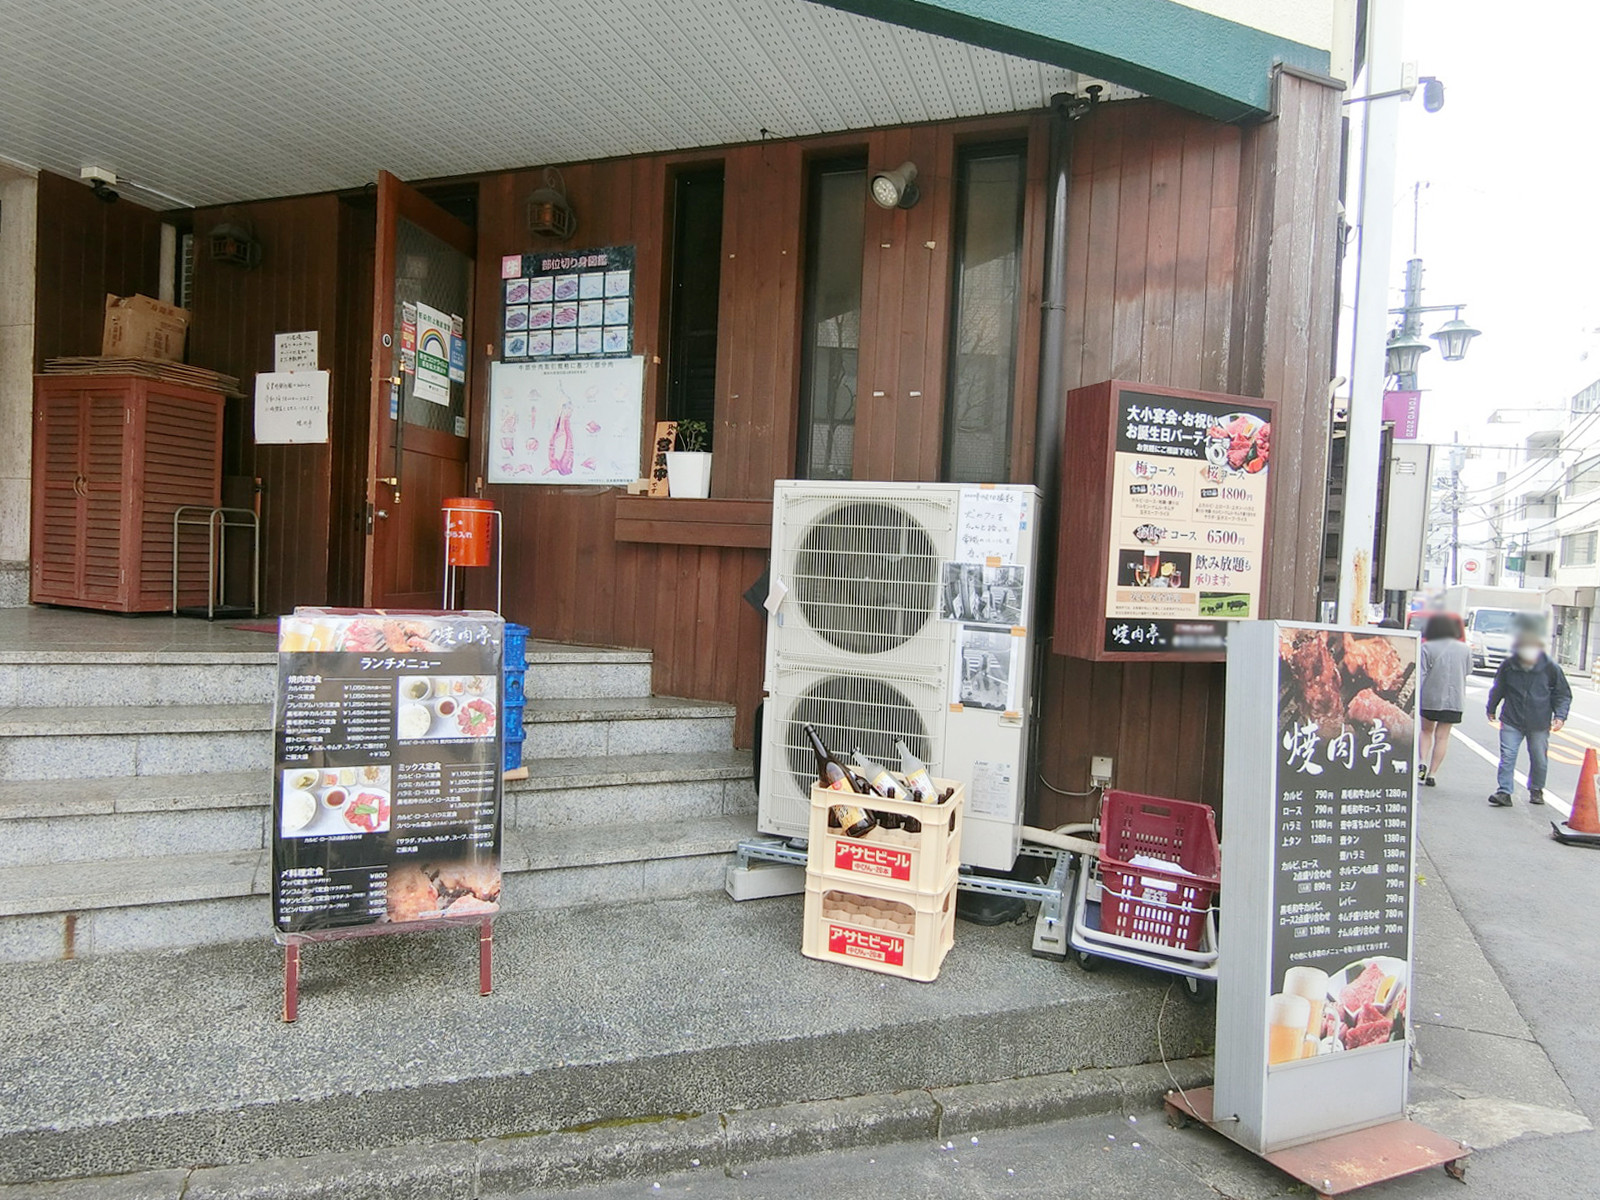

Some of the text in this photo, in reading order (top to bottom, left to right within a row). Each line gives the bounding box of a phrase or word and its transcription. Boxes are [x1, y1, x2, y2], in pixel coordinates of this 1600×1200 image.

[541, 255, 608, 271] 部位切り身図鑑
[1126, 404, 1219, 428] 大小宴会・お祝い
[1405, 397, 1416, 437] TOKYO 2020
[1149, 483, 1184, 498] 3500円
[1221, 487, 1253, 501] 4800円
[1207, 529, 1245, 545] 6500円
[1195, 554, 1251, 572] 飲み放題も
[1195, 573, 1232, 587] 承ります。
[434, 625, 492, 645] 焼肉亭
[1112, 623, 1160, 645] 焼肉亭
[360, 657, 441, 670] ランチメニュー
[288, 675, 322, 684] 焼肉定食
[1283, 718, 1392, 775] 焼肉亭
[398, 762, 441, 771] ミックス定食
[1283, 788, 1407, 801] カルビ 790円 黒毛和牛カルビ 1280円
[1282, 803, 1407, 816] ロース 790円 黒毛和牛ロース 1280円
[1282, 821, 1301, 831] ハラミ
[1311, 820, 1333, 830] 1180円
[1281, 836, 1302, 847] 上タン
[1310, 835, 1332, 845] 1280円
[837, 843, 910, 868] アサヒビール
[1313, 882, 1332, 892] 890円
[1339, 881, 1357, 892] 上ミノ
[1386, 879, 1405, 889] 790円
[1339, 894, 1405, 907] レバー 790円
[1338, 909, 1381, 923] キムチ盛り合わせ
[1384, 908, 1404, 919] 780円
[1337, 924, 1381, 938] ナムル盛り合わせ
[831, 927, 903, 953] アサヒビール
